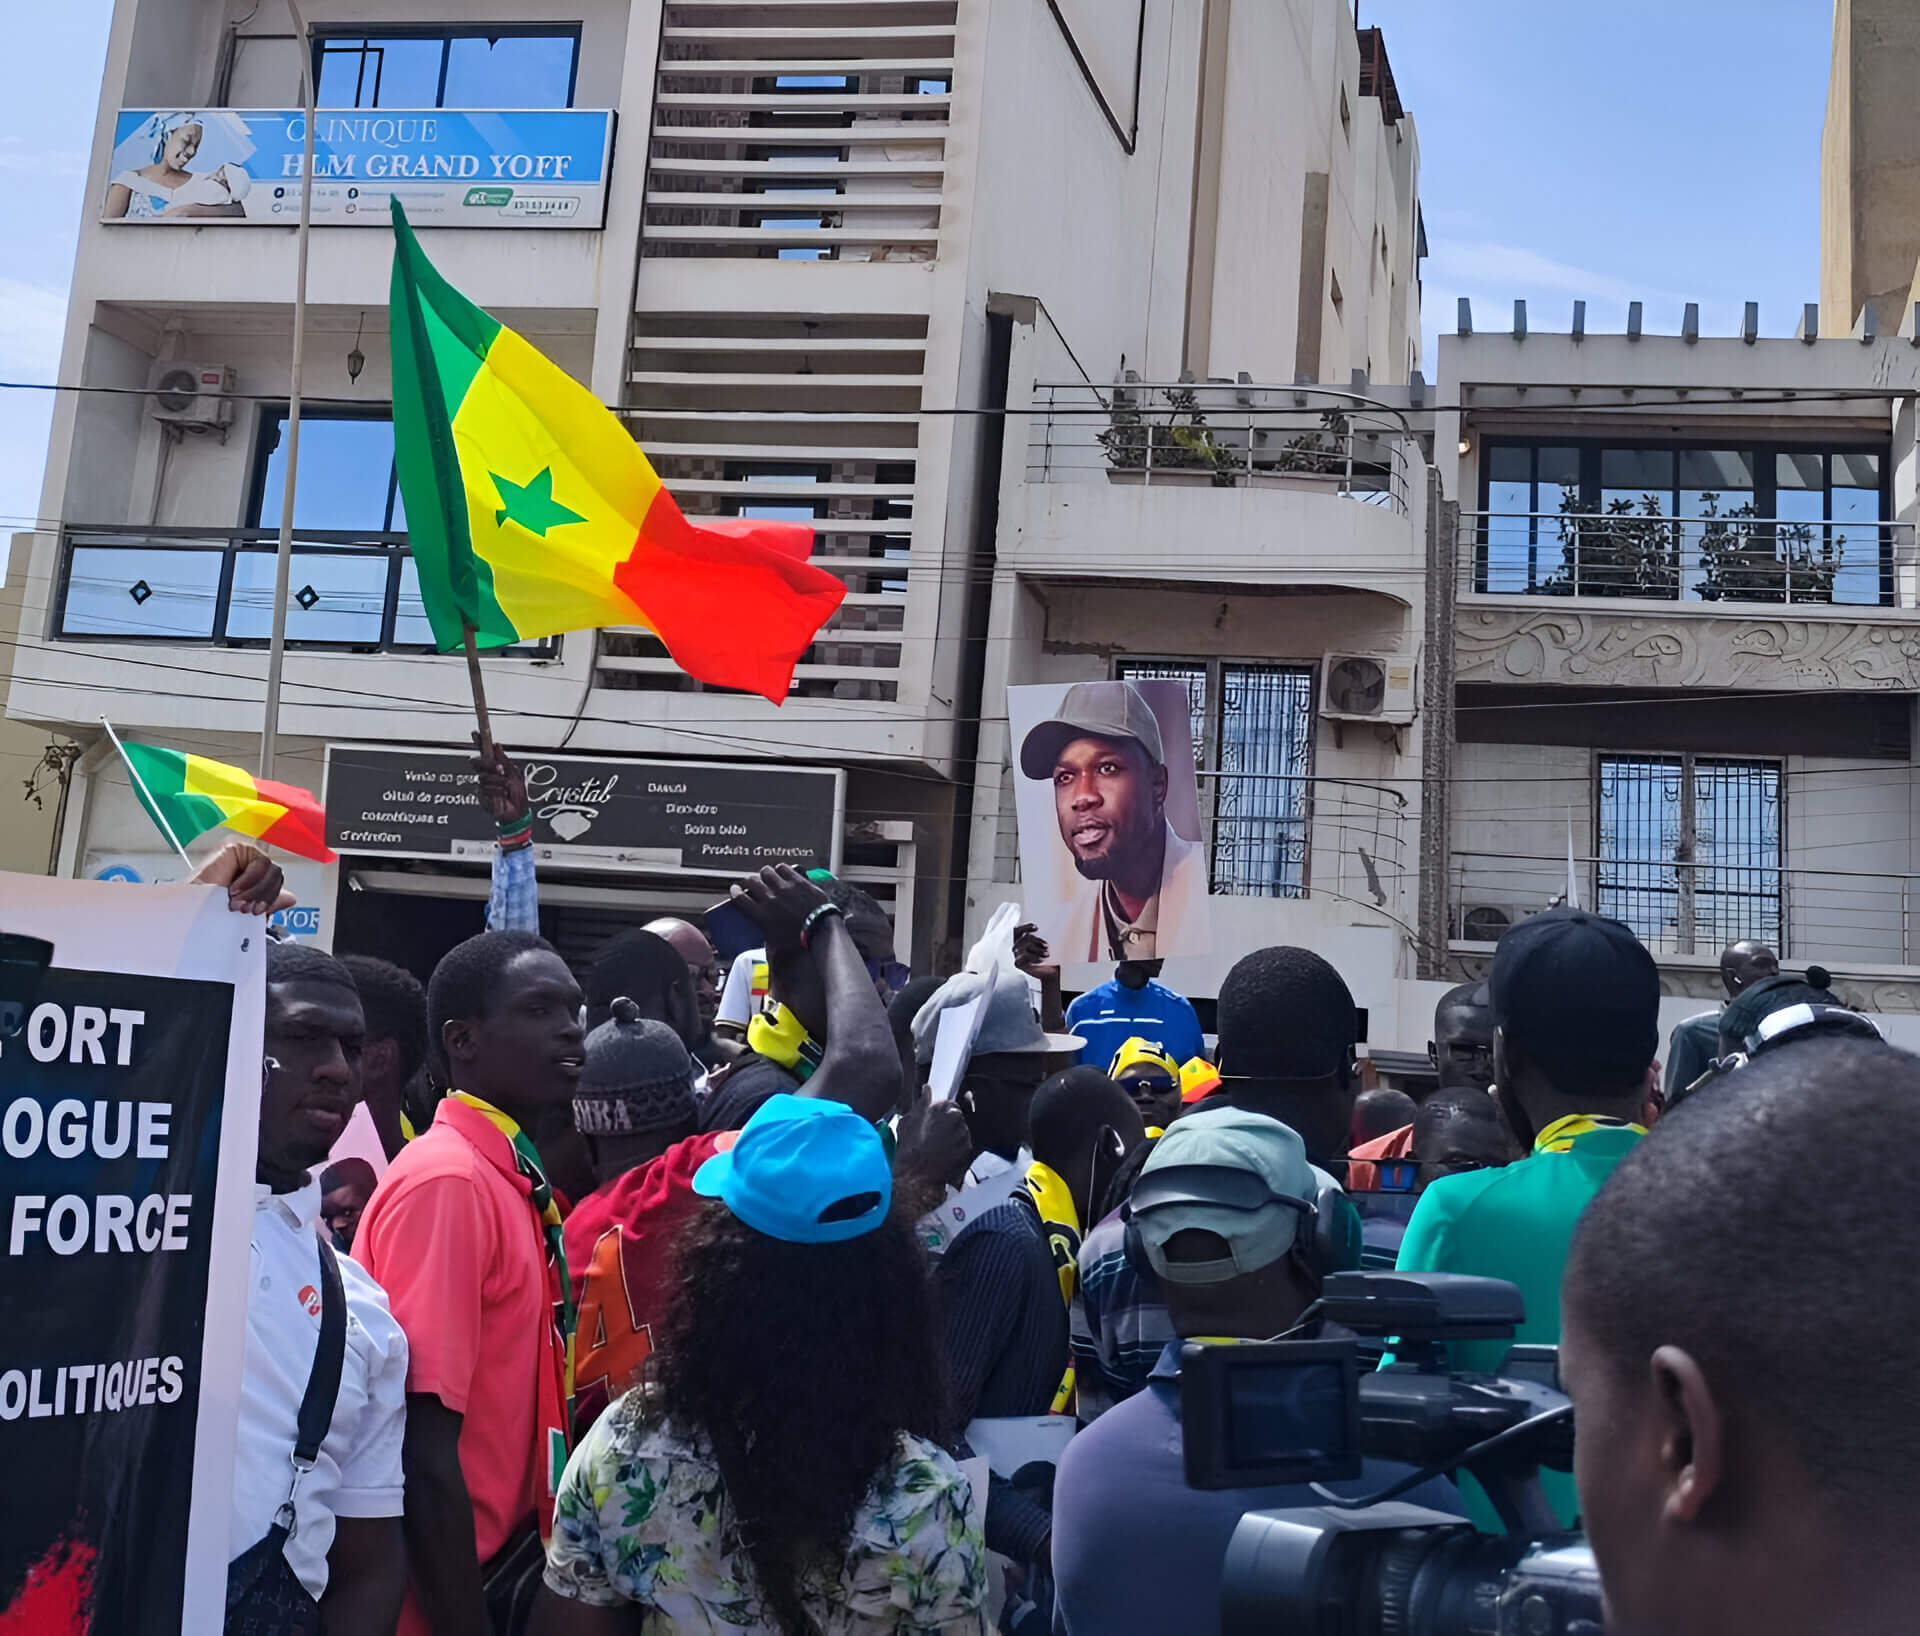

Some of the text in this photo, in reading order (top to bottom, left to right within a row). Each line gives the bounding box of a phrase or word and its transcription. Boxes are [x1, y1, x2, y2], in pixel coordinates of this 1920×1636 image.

[281, 153, 572, 179] HLM GRAND YOFF
[524, 763, 619, 819] Crystal
[2, 1096, 173, 1160] OGUE
[9, 1193, 193, 1257] FORCE
[0, 1355, 185, 1421] OLITIQUES
